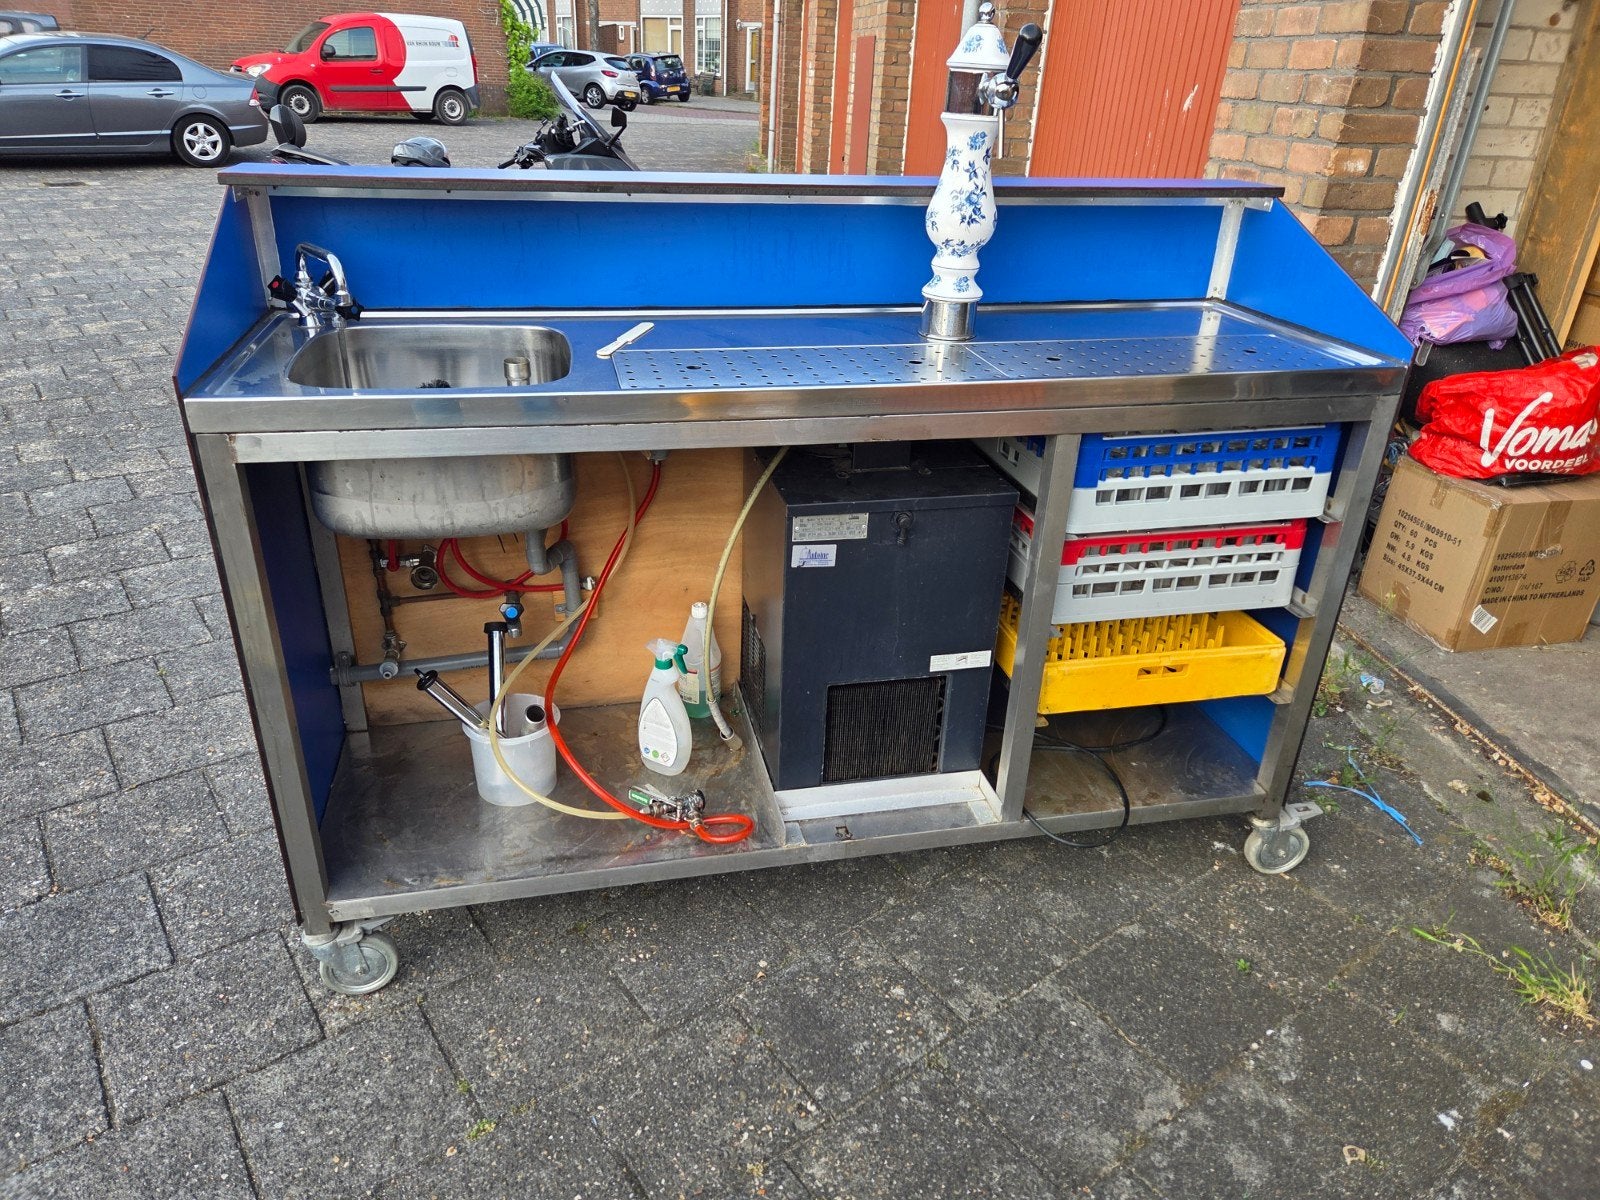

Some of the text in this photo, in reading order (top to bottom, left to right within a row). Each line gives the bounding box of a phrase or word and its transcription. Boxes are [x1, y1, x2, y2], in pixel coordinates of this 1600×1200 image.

[1504, 453, 1589, 471] VOORDEEL
[1394, 521, 1406, 532] QTY:
[1424, 537, 1437, 548] PCS
[1405, 540, 1415, 550] 5.9
[1420, 549, 1434, 560] KGS
[1416, 560, 1430, 571] KGS
[1433, 582, 1445, 594] CM
[1481, 597, 1498, 605] MADE
[1507, 594, 1527, 602] CHINA
[1538, 590, 1585, 599] NETHERLANDS
